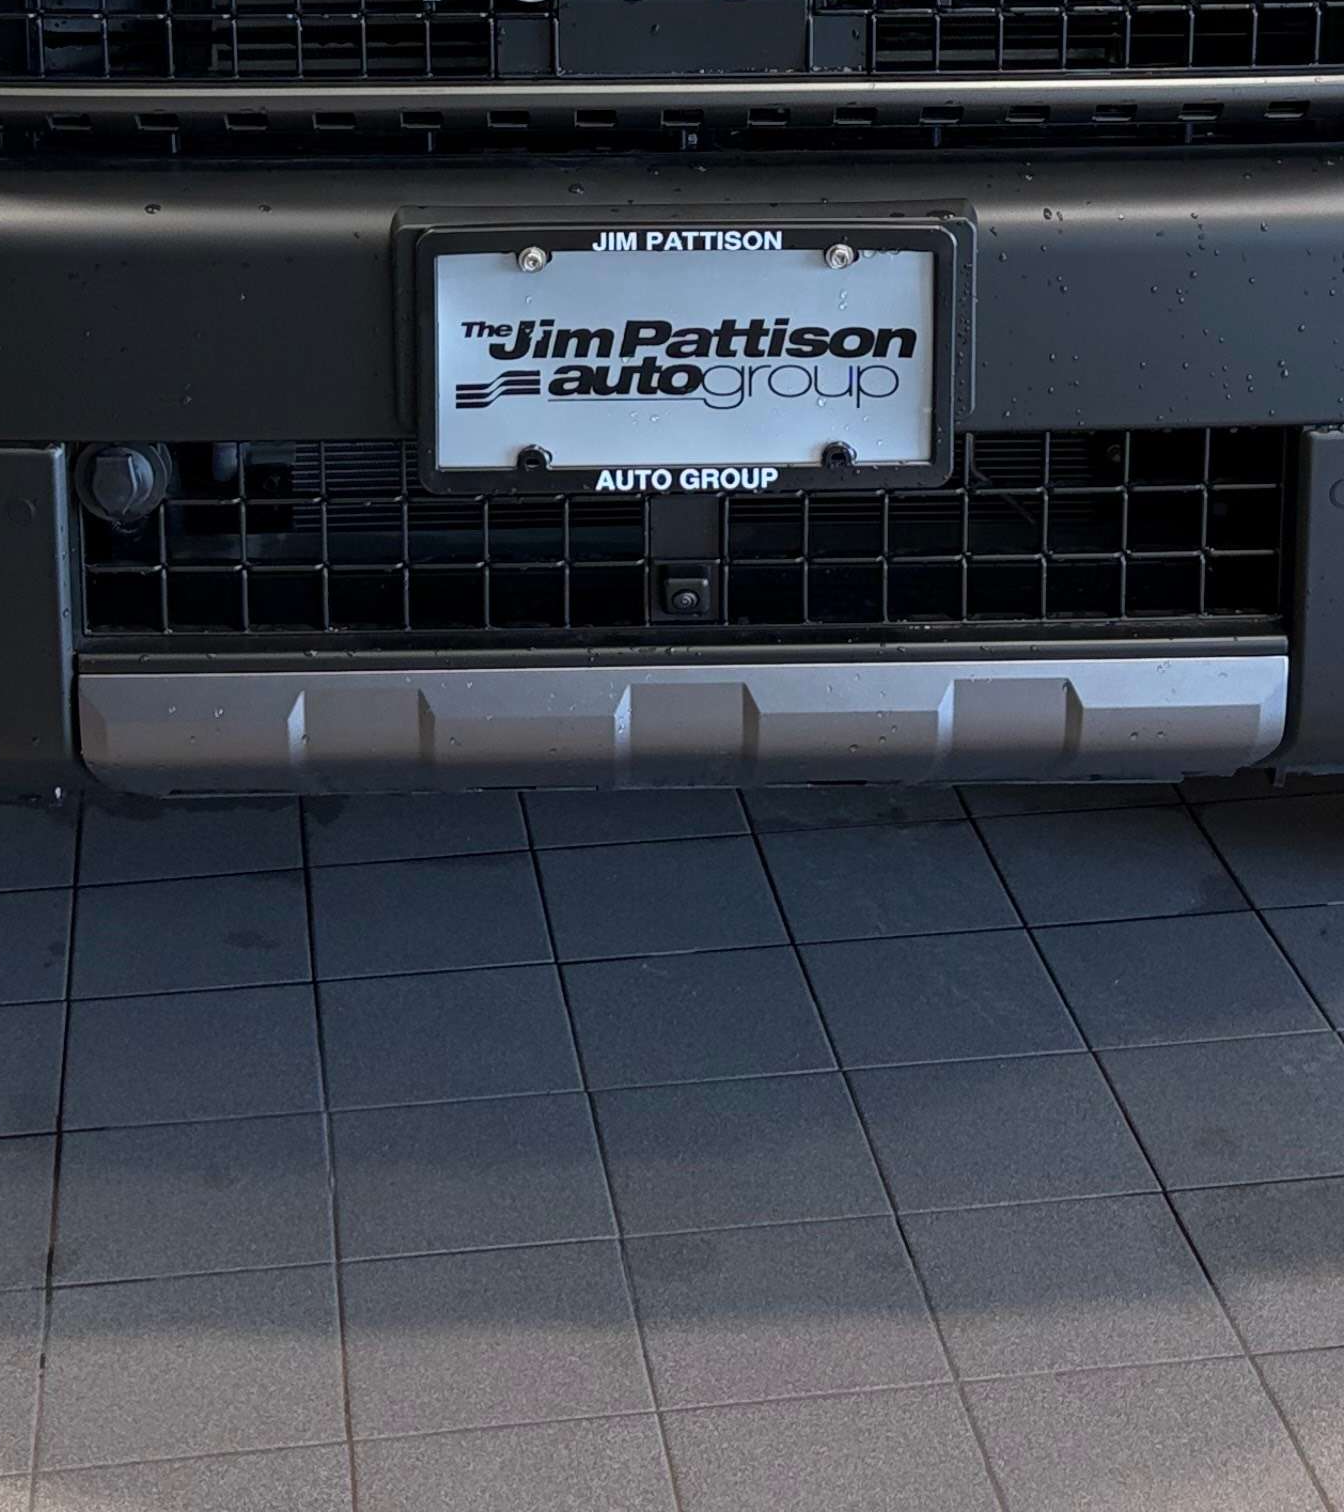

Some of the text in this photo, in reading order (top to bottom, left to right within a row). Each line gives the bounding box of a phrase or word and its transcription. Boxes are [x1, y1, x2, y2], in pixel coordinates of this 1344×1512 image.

[592, 230, 783, 251] JIM PATTISON
[461, 317, 918, 360] The Jim Pattison
[595, 467, 779, 491] AUTO GROUP
